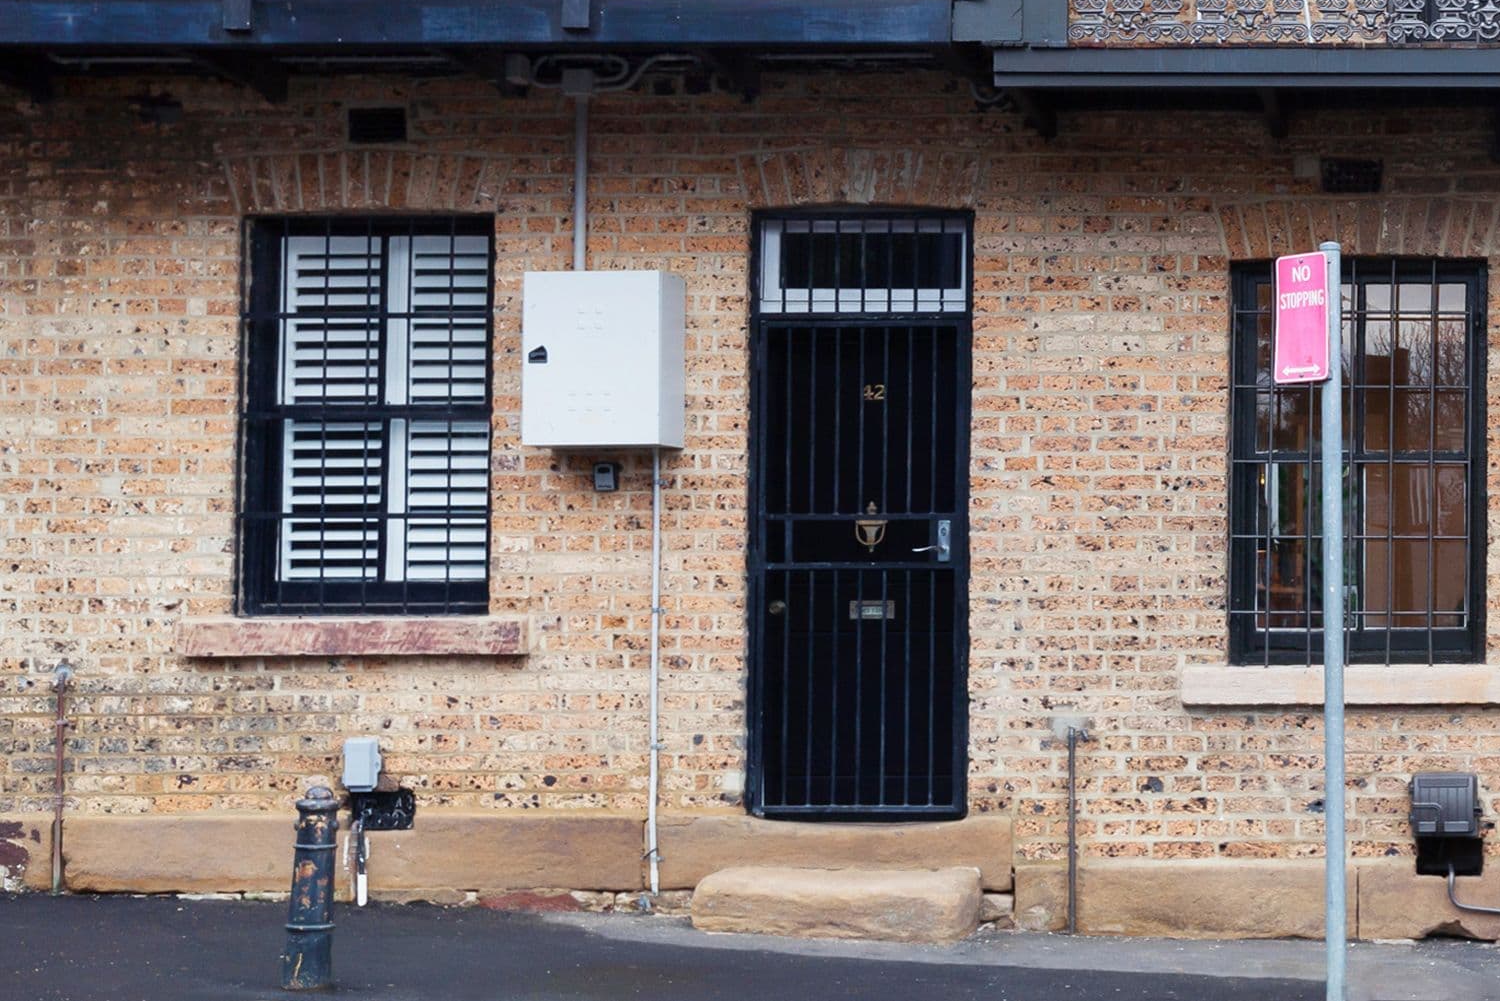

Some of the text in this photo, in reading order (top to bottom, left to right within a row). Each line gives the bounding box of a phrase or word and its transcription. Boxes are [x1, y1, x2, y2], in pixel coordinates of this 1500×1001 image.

[1292, 265, 1311, 282] NO
[1280, 289, 1325, 310] STOPPING
[863, 384, 886, 400] 42
